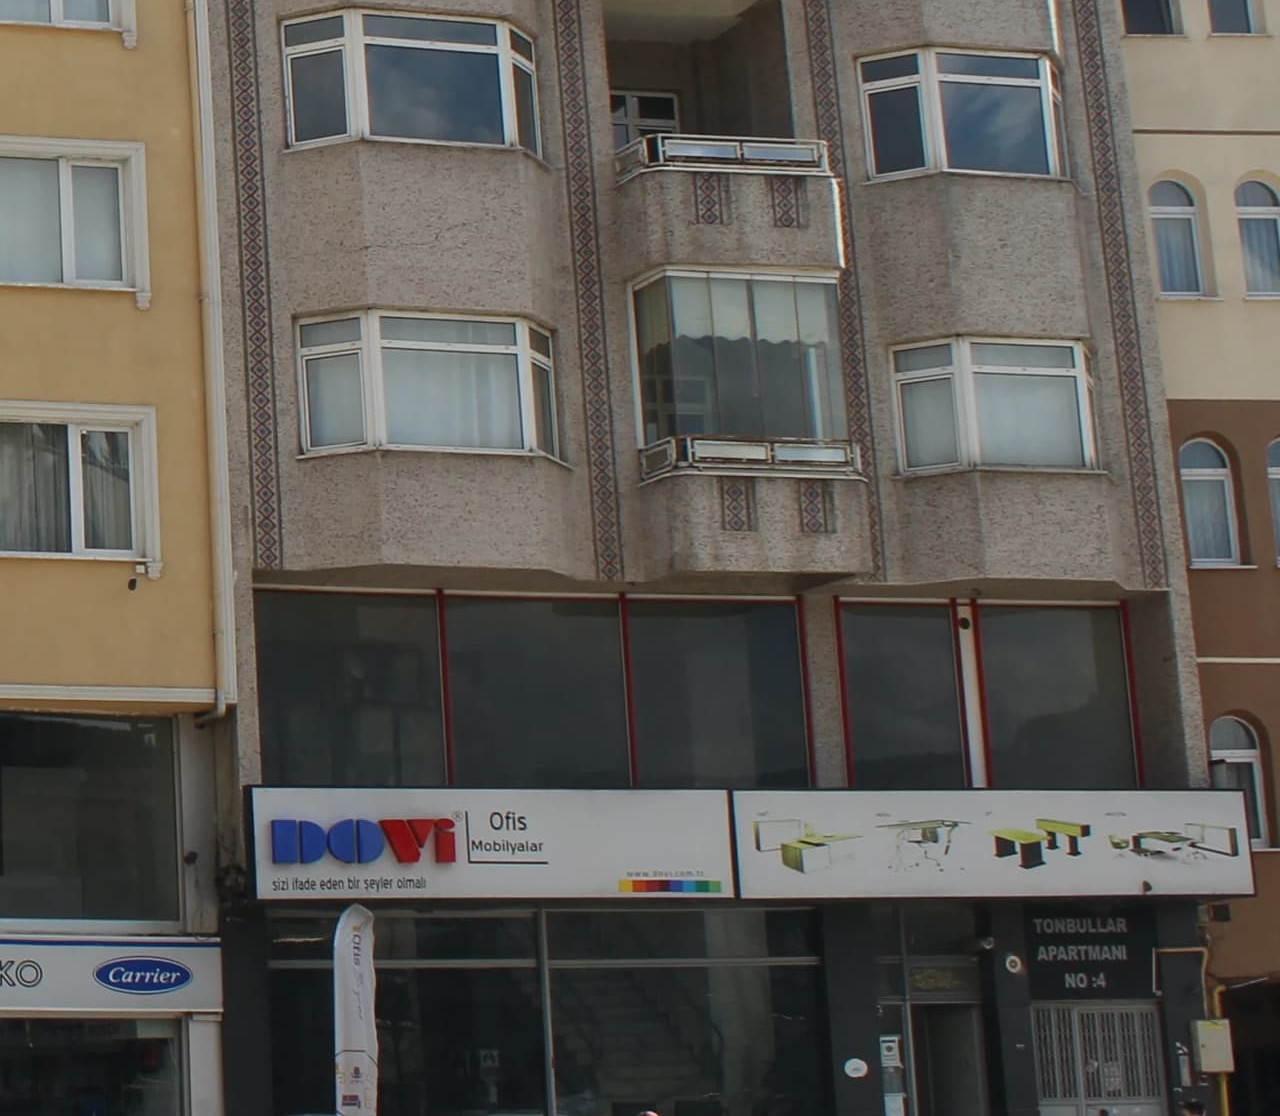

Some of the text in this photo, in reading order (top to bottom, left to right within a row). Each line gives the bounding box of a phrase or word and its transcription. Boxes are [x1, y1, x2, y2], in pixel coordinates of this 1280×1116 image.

[489, 811, 528, 831] Ofis
[471, 839, 544, 855] Mobilyalar
[272, 877, 289, 892] sizi
[292, 877, 317, 891] ifade
[319, 877, 345, 890] eden
[347, 876, 361, 890] bir
[363, 877, 394, 893] şeyler
[1032, 917, 1128, 934] TONBULLAR
[1037, 945, 1128, 961] APARTMANI
[108, 966, 182, 984] Carrier
[1064, 973, 1087, 988] NO
